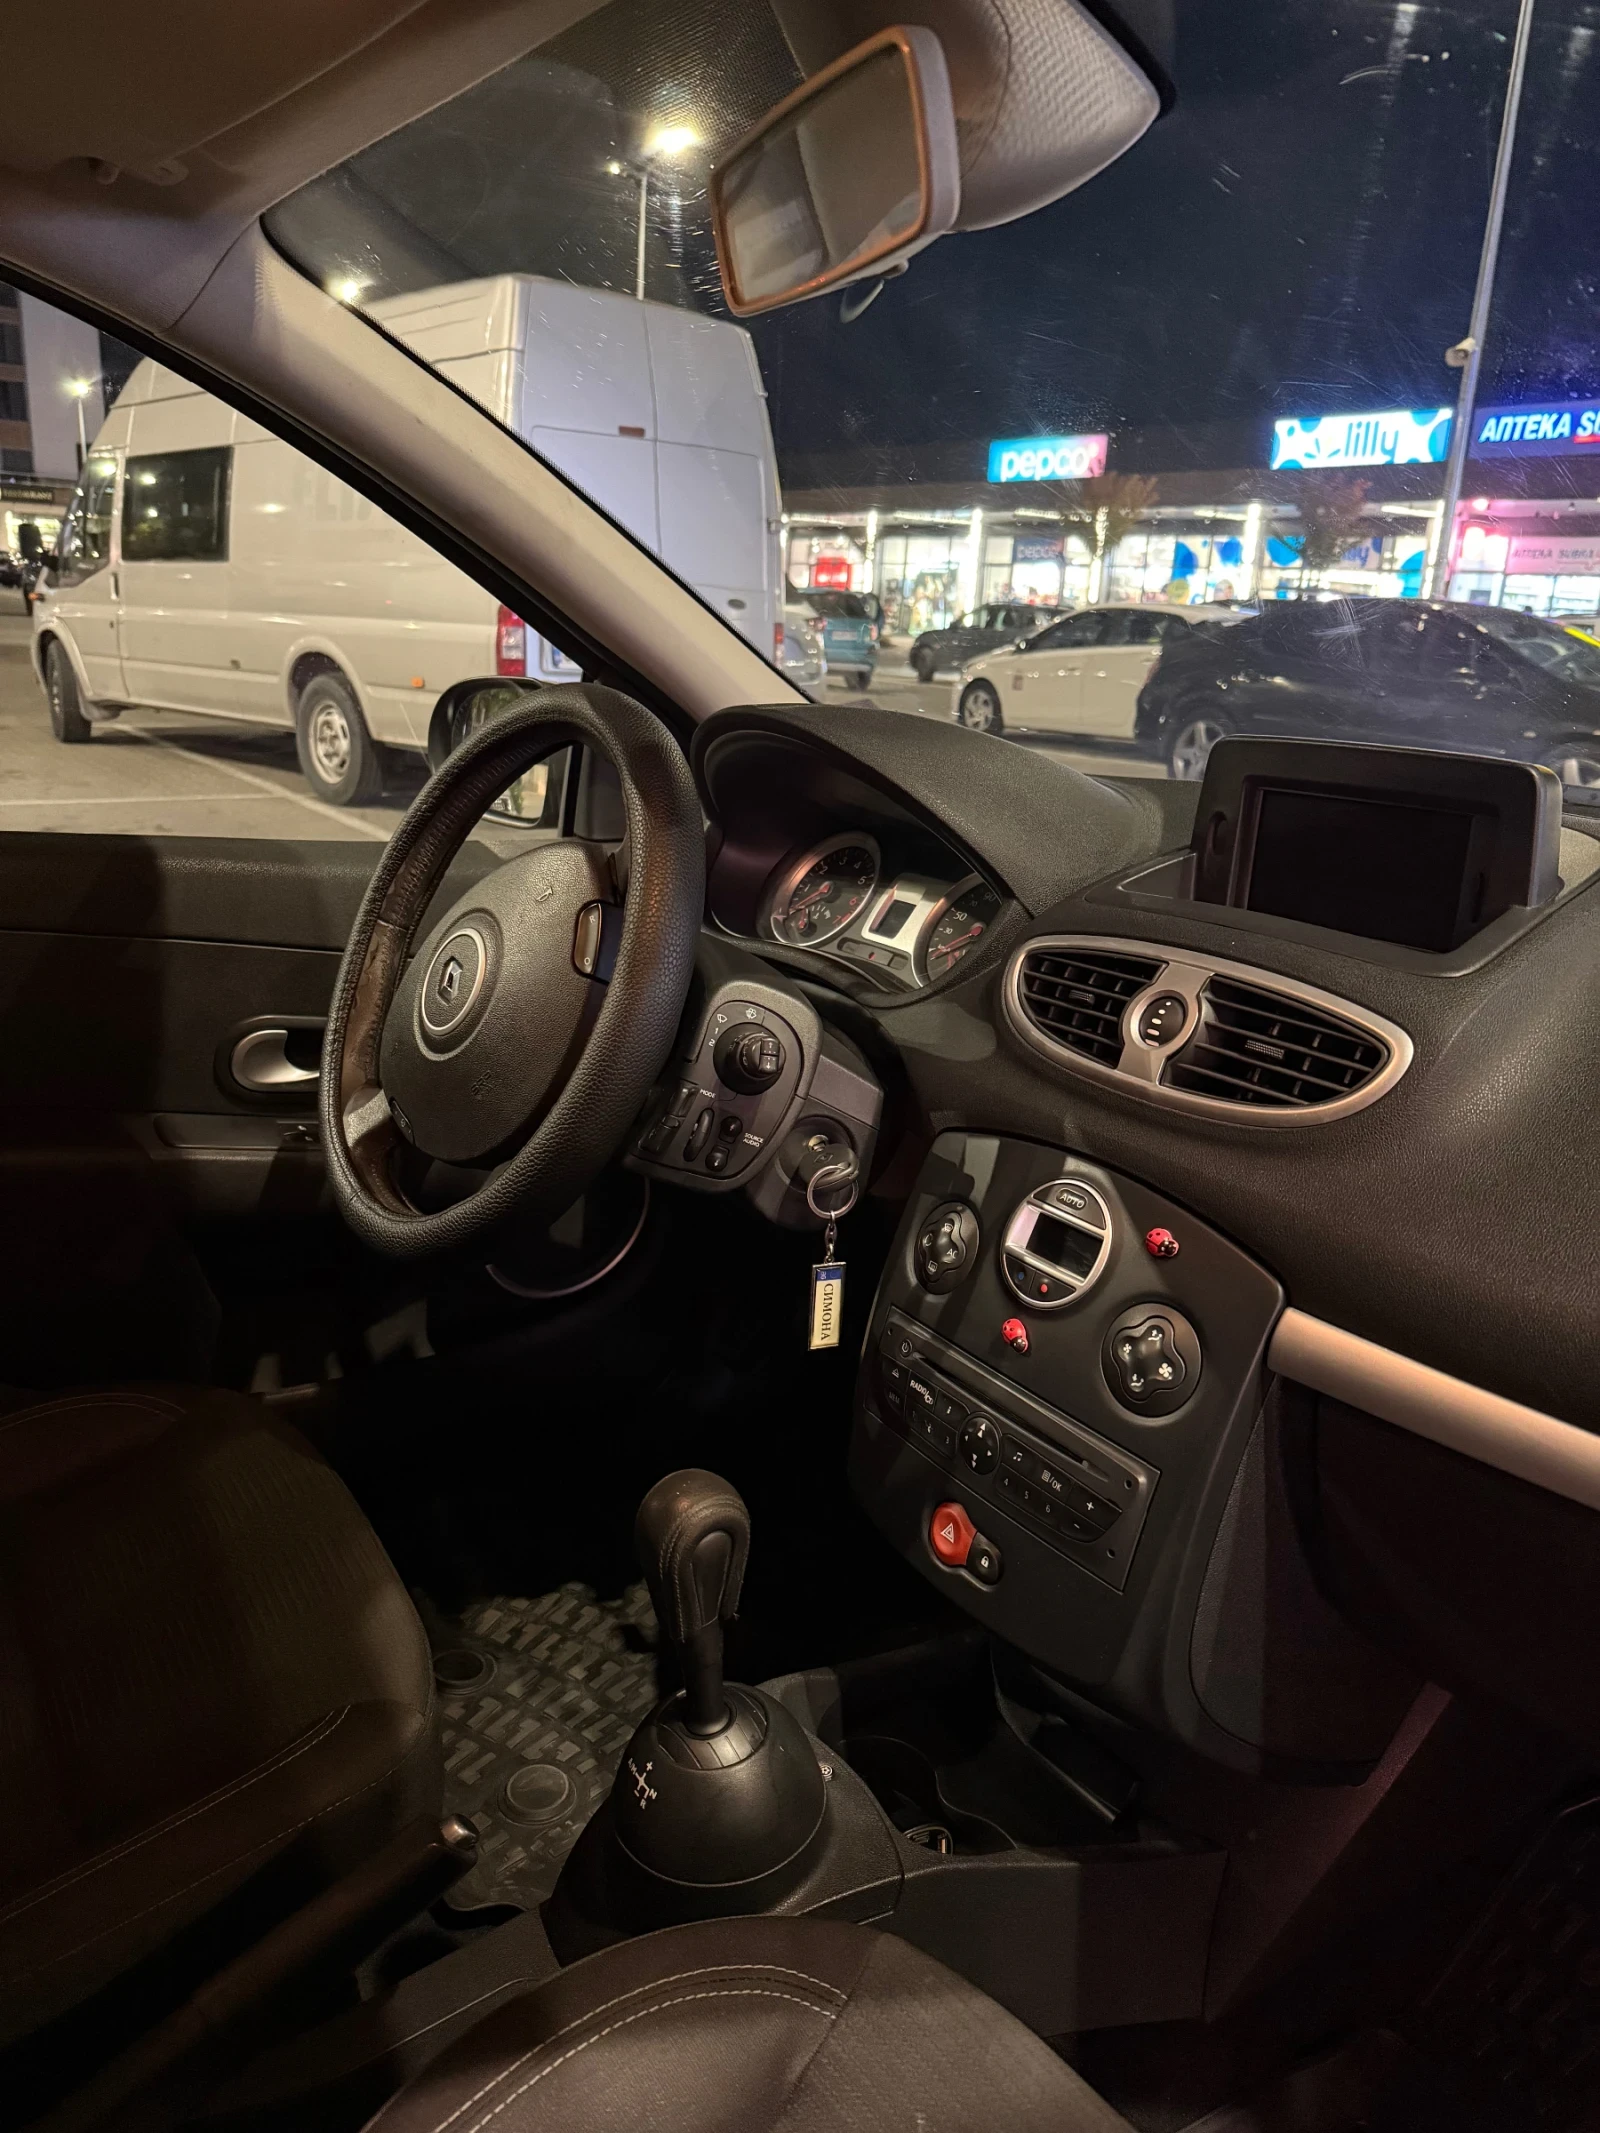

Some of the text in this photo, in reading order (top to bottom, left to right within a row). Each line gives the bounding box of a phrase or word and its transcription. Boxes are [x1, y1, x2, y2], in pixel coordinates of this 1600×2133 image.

[1478, 412, 1571, 442] АПТЕКА
[1344, 421, 1399, 464] lilly
[1001, 446, 1090, 482] pepco
[820, 866, 828, 875] 2
[857, 876, 867, 885] 5
[849, 897, 858, 906] 6
[588, 915, 595, 924] R
[953, 911, 967, 921] 50
[715, 1027, 719, 1035] 1
[708, 1038, 716, 1047] 2
[700, 1088, 716, 1099] MODE
[743, 1138, 760, 1148] AUDIO
[744, 1132, 764, 1144] SOURCE
[1059, 1193, 1085, 1209] AUTO
[946, 1248, 958, 1260] AC
[820, 1283, 834, 1341] СИМОНА
[1004, 1478, 1009, 1486] 4
[1024, 1491, 1029, 1499] 5
[1045, 1504, 1051, 1513] 6
[649, 1788, 657, 1799] N
[640, 1799, 646, 1809] R
